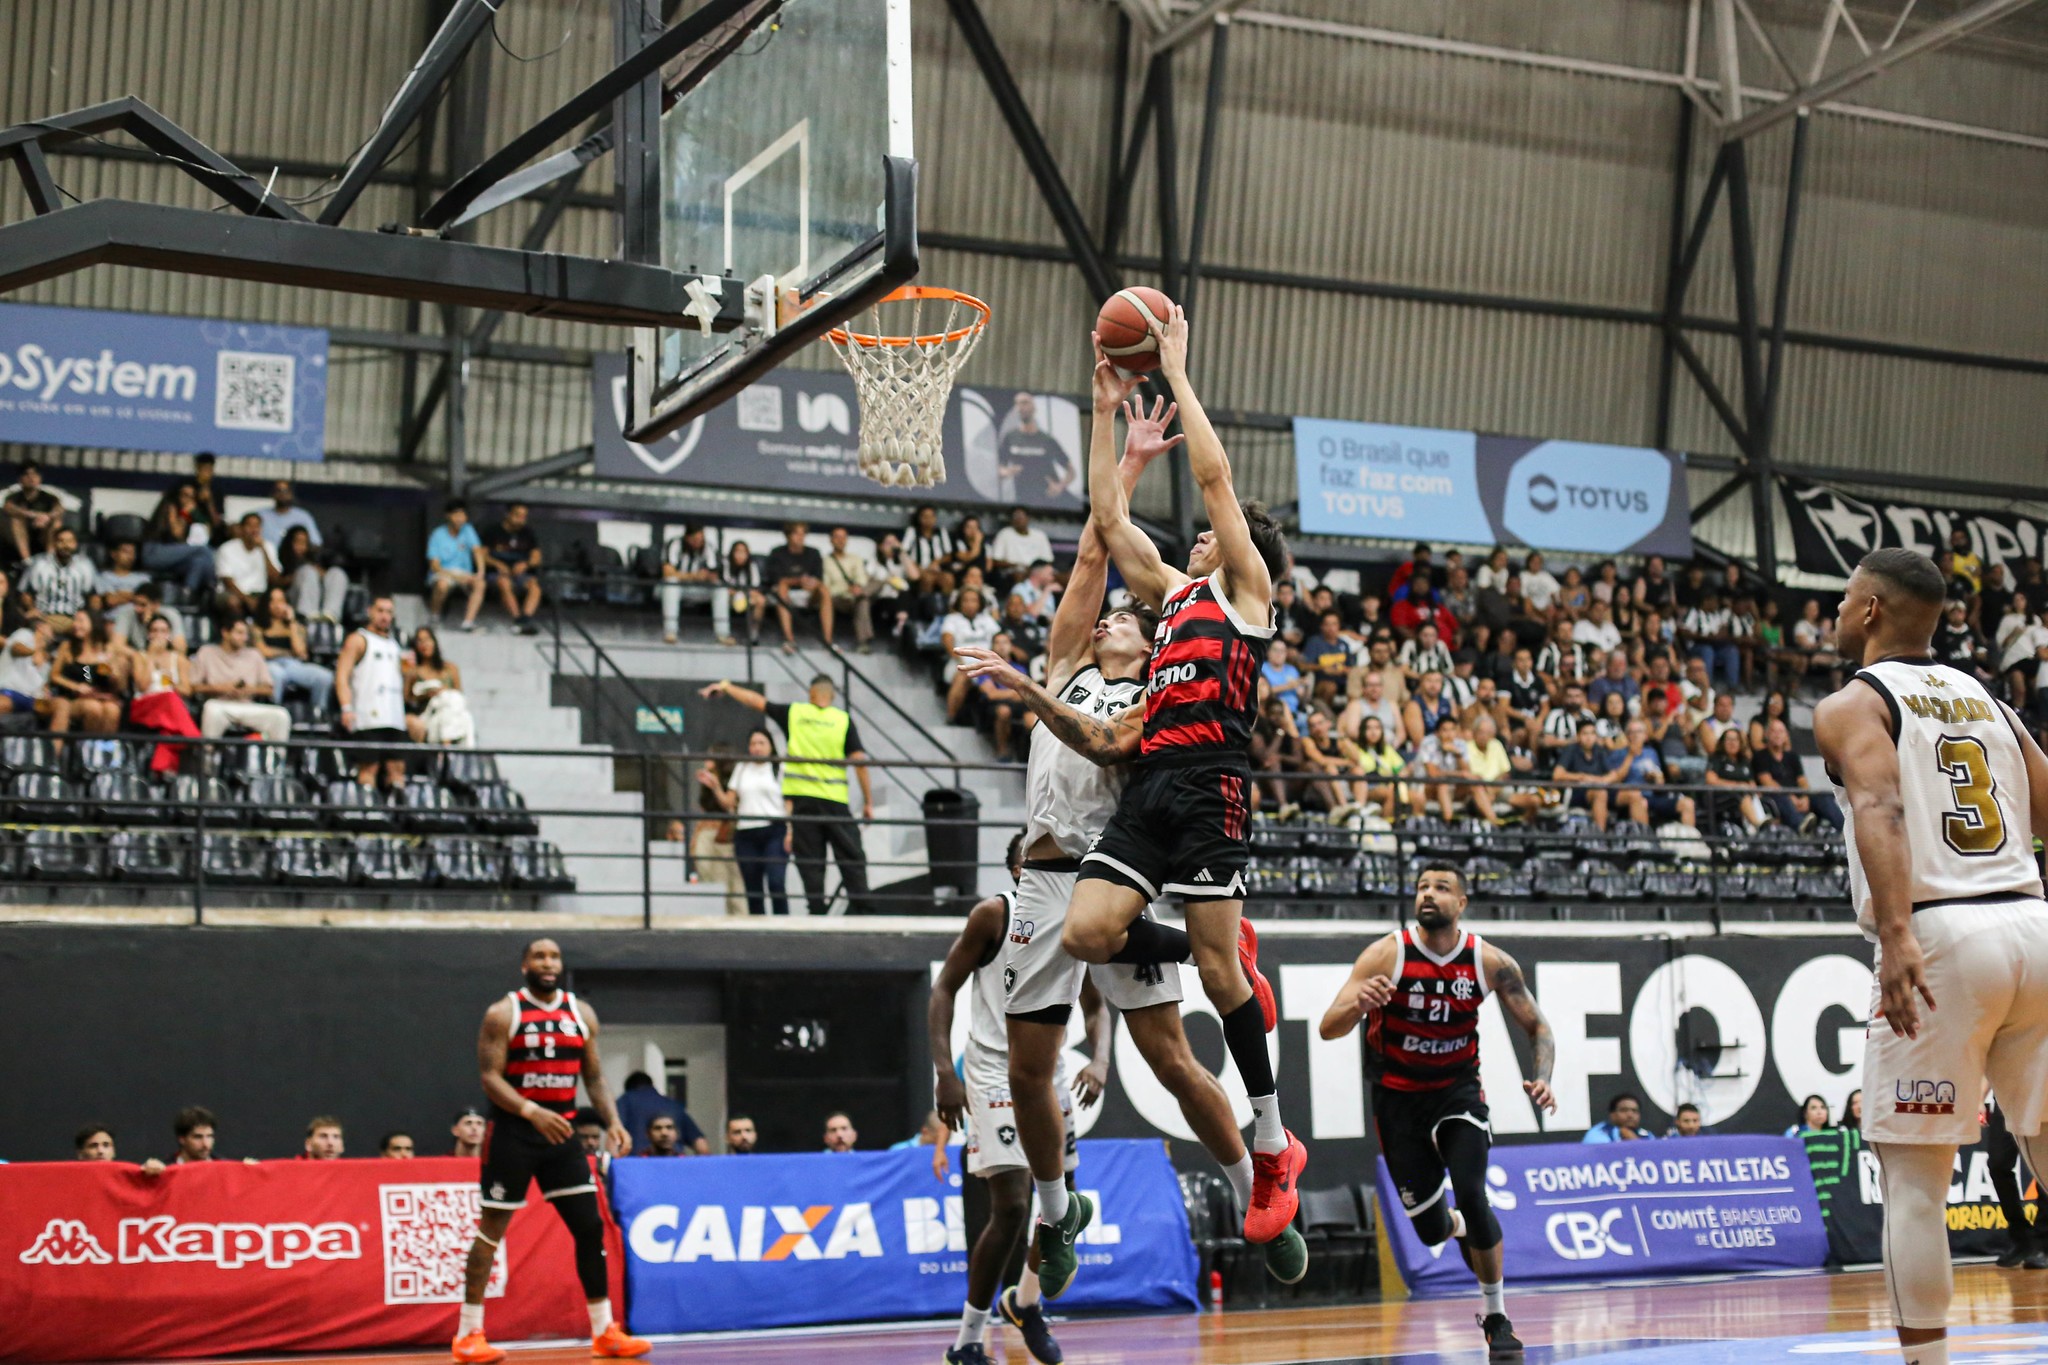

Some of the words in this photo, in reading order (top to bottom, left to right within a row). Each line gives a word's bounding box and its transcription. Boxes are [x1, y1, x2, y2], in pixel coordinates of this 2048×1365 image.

[1318, 436, 1337, 458] O
[1342, 437, 1402, 465] Brasil
[1407, 446, 1450, 470] que
[1320, 463, 1353, 486] faz
[1359, 465, 1397, 492] faz
[1401, 473, 1453, 496] com
[1148, 662, 1197, 697] tano
[1935, 733, 2007, 857] 3
[1429, 999, 1450, 1023] 21
[544, 1036, 556, 1058] 2
[1896, 1078, 1956, 1103] UPA
[1907, 1103, 1943, 1114] PET
[1524, 1157, 1659, 1192] FORMAÇÃO
[1661, 1158, 1696, 1184] DE
[1698, 1156, 1791, 1183] ATLETAS
[628, 1202, 884, 1263] CAIXA
[1545, 1207, 1634, 1261] CBC
[1650, 1205, 1720, 1231] COMITÊ
[1720, 1205, 1802, 1227] BRASILEIRO
[118, 1215, 362, 1269] Kappa
[1709, 1226, 1777, 1249] CLUBES
